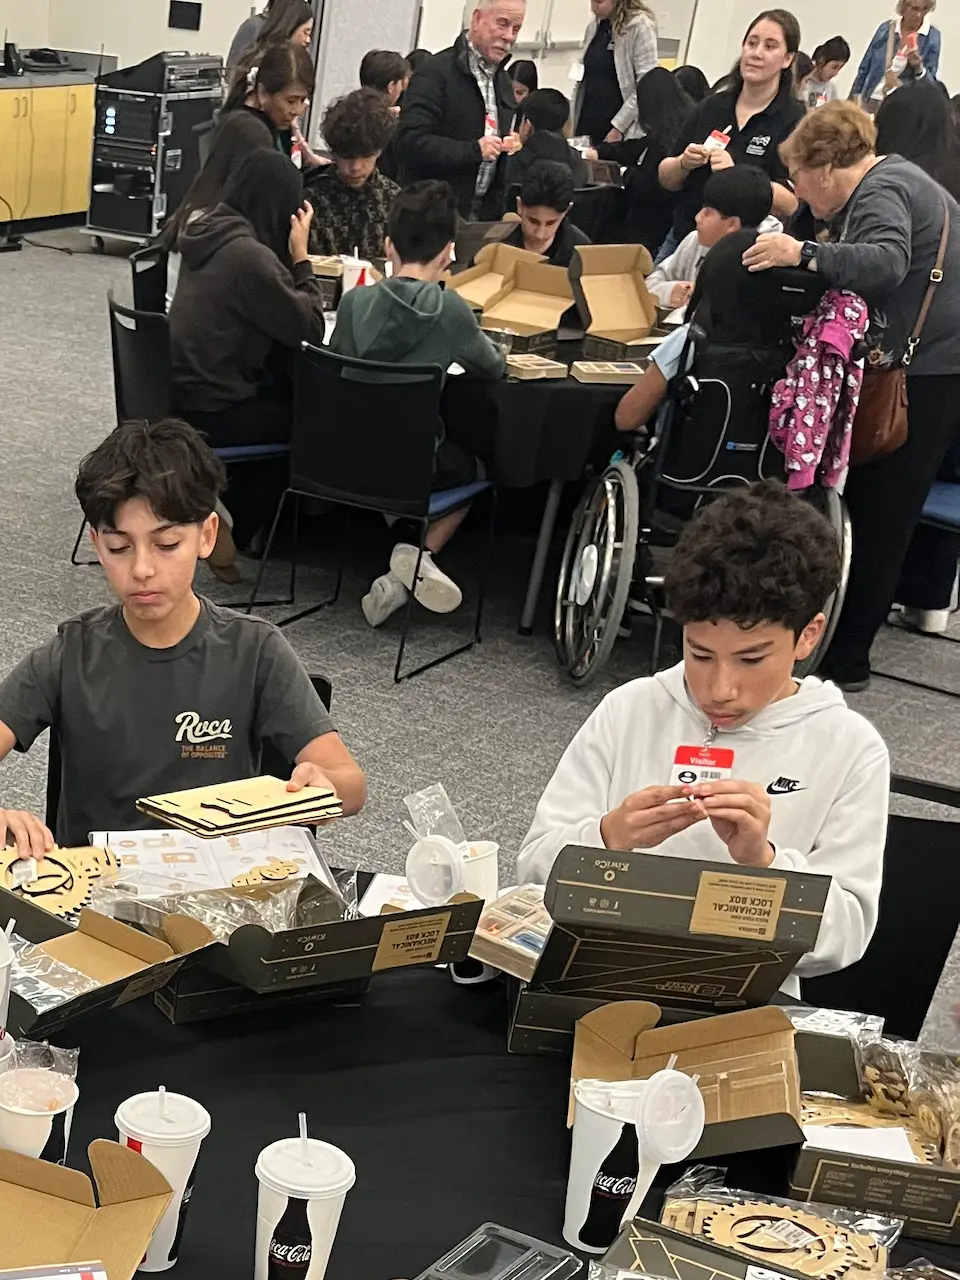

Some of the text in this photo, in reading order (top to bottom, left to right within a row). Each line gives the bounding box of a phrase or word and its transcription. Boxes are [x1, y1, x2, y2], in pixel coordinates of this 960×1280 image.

[594, 860, 630, 872] KiwiCo
[729, 895, 773, 908] LOCK BOX
[712, 902, 771, 917] MECHANICAL
[420, 930, 440, 939] LOCK
[392, 937, 437, 950] MECHANICAL
[594, 1172, 637, 1194] oca-Cola
[270, 1239, 312, 1262] oca-Cola
